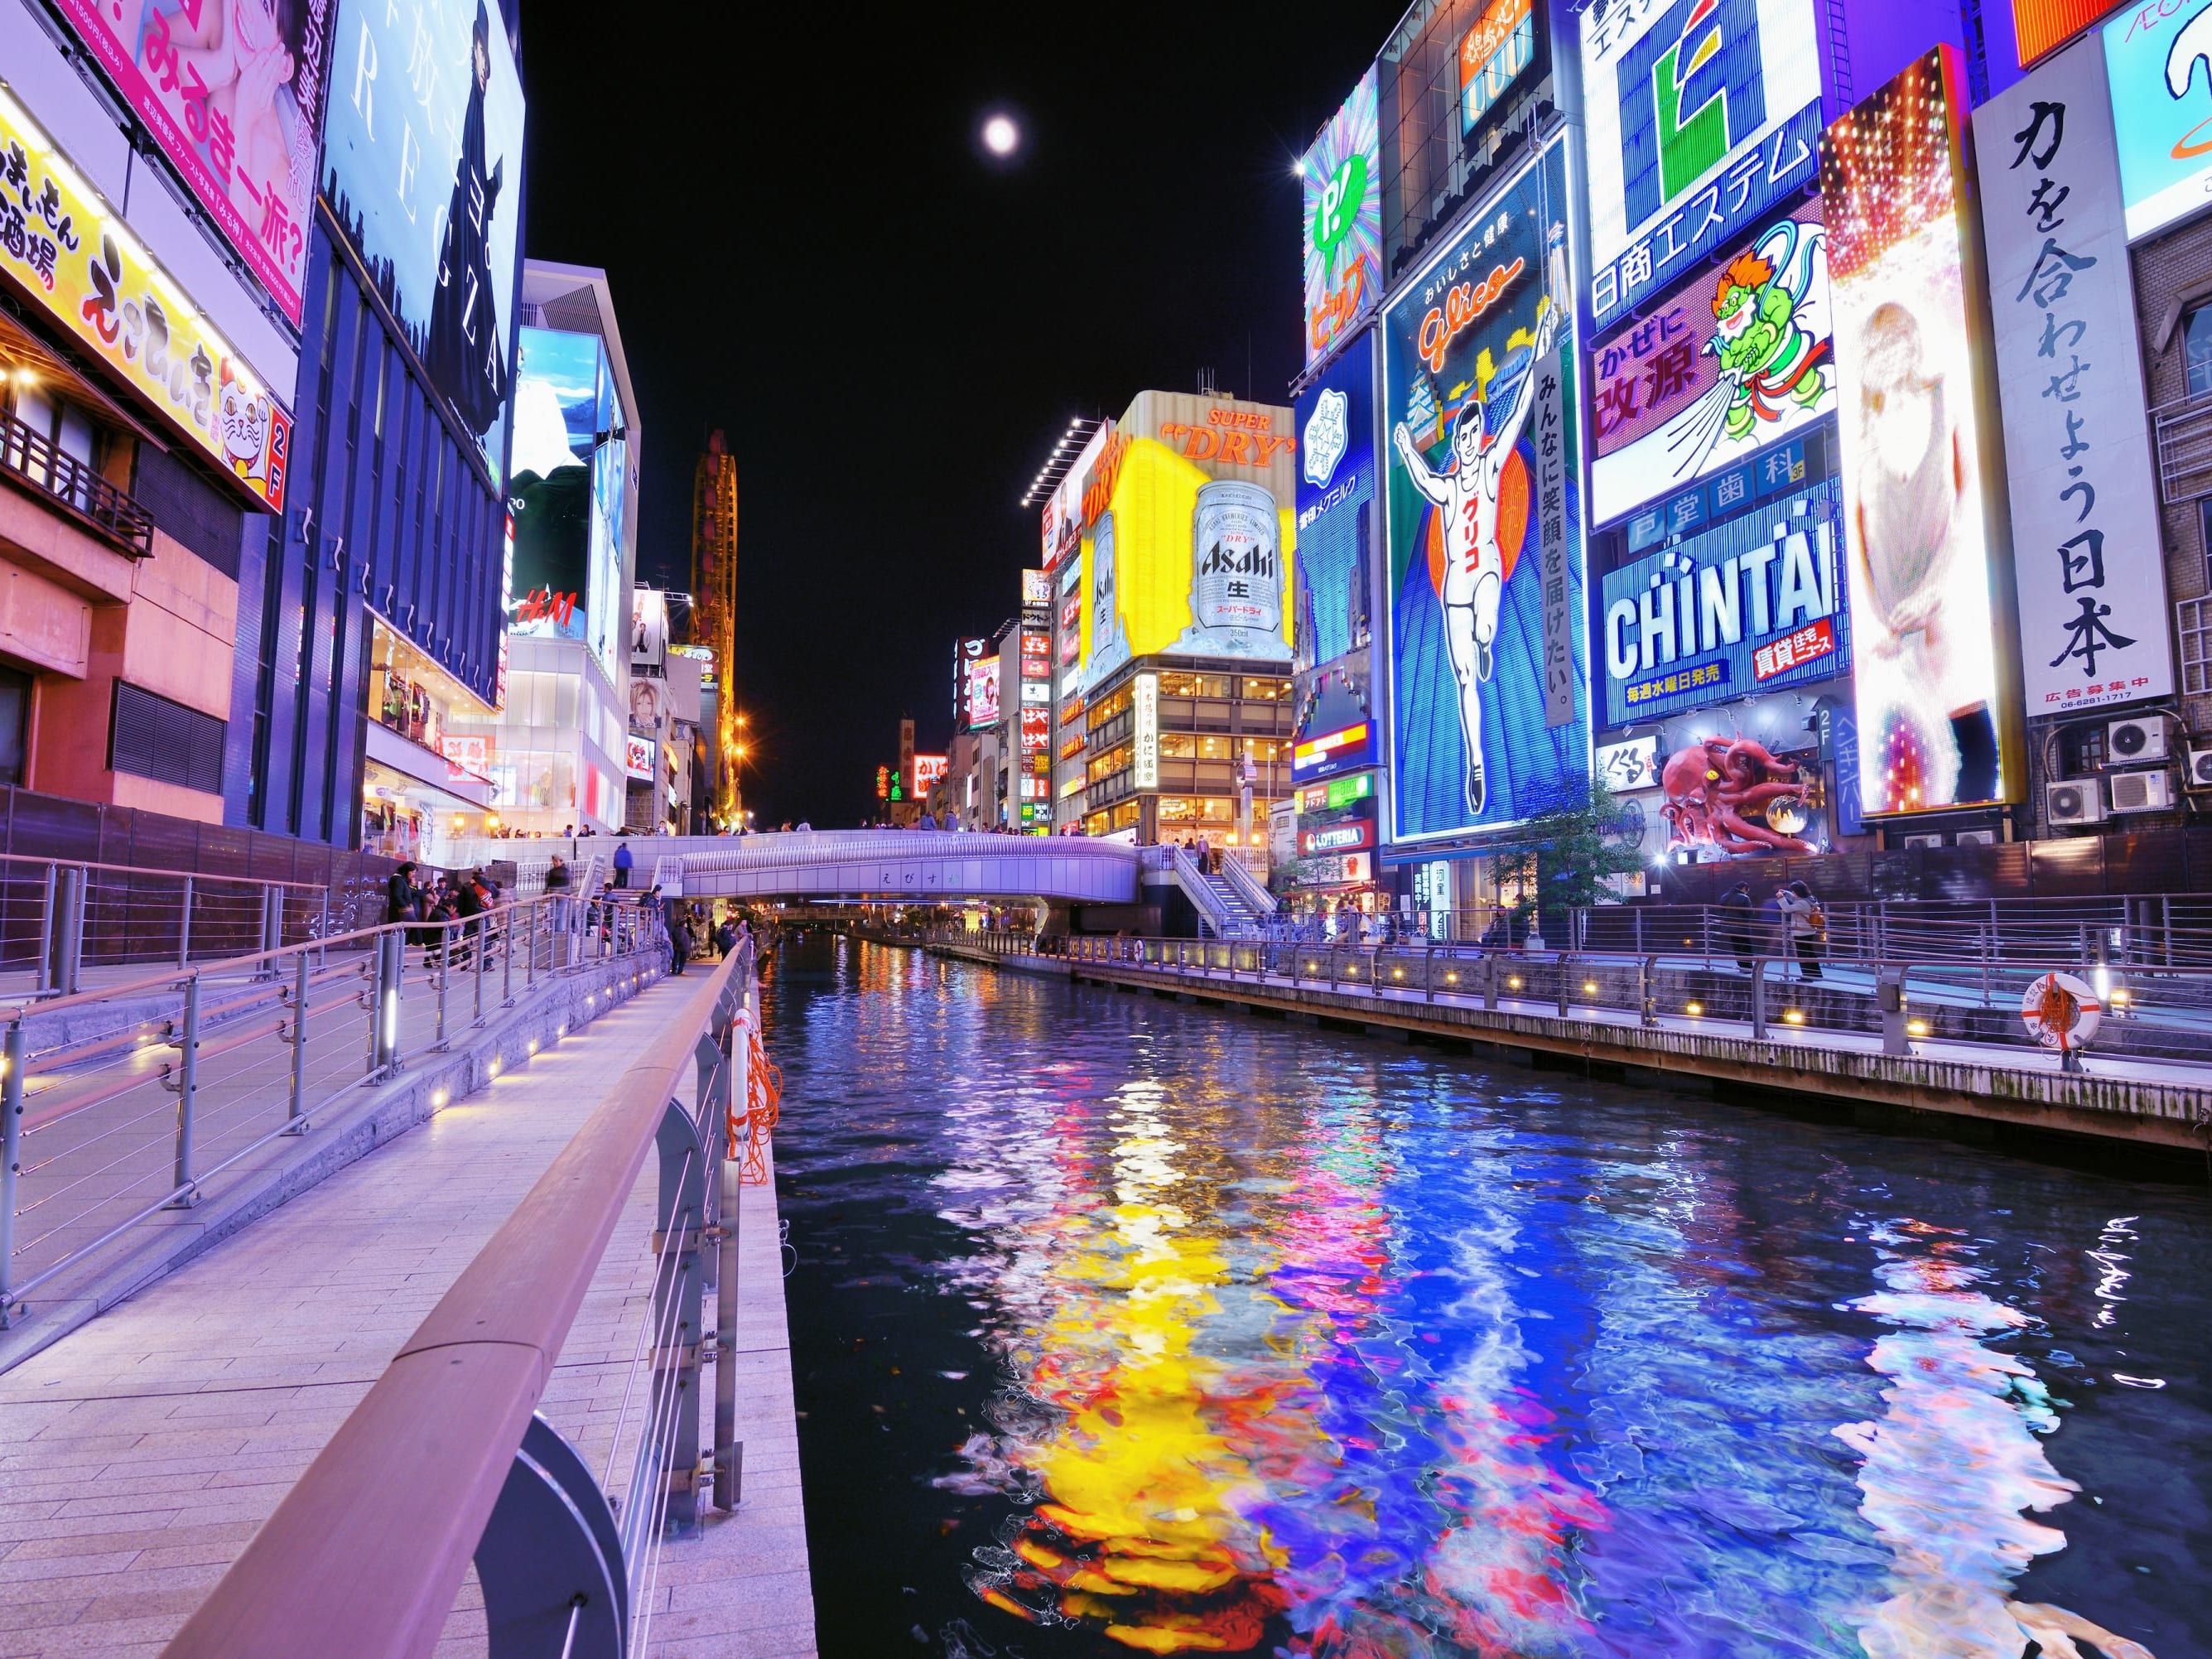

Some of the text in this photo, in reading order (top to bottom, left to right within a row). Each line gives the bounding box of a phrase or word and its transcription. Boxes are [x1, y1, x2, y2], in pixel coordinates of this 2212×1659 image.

[1593, 130, 1812, 317] 日商エステム
[1424, 211, 1509, 304] おいしさと健康
[1311, 252, 1366, 350] ピップ
[1418, 256, 1524, 373] Glico
[1600, 306, 1688, 380] かぜに
[1593, 341, 1699, 439] 改源
[2009, 102, 2137, 677] 力を合わせよう日本
[1207, 409, 1271, 430] SUPER
[269, 424, 285, 497] 2F
[1792, 465, 1804, 480] 3F
[1299, 475, 1357, 530] 雪印メグミルク
[1462, 490, 1480, 573] グリコ
[1539, 373, 1568, 705] みんなに笑顔を届けたい。
[1202, 540, 1274, 579] Asahi
[516, 588, 577, 628] H&M
[1217, 605, 1262, 615] スーパードライ
[1226, 581, 1250, 598] 生
[1607, 507, 1833, 679] CHINTAI
[1230, 629, 1249, 638] 350ml
[1754, 637, 1832, 679] 賃貸 ニュース
[1626, 663, 1721, 704] 毎週水曜日発売
[2045, 677, 2149, 703] 広告募集中
[2060, 692, 2132, 709] 06-6281-1717
[1820, 710, 1830, 745] 2F
[1316, 827, 1359, 846] LOTTERIA
